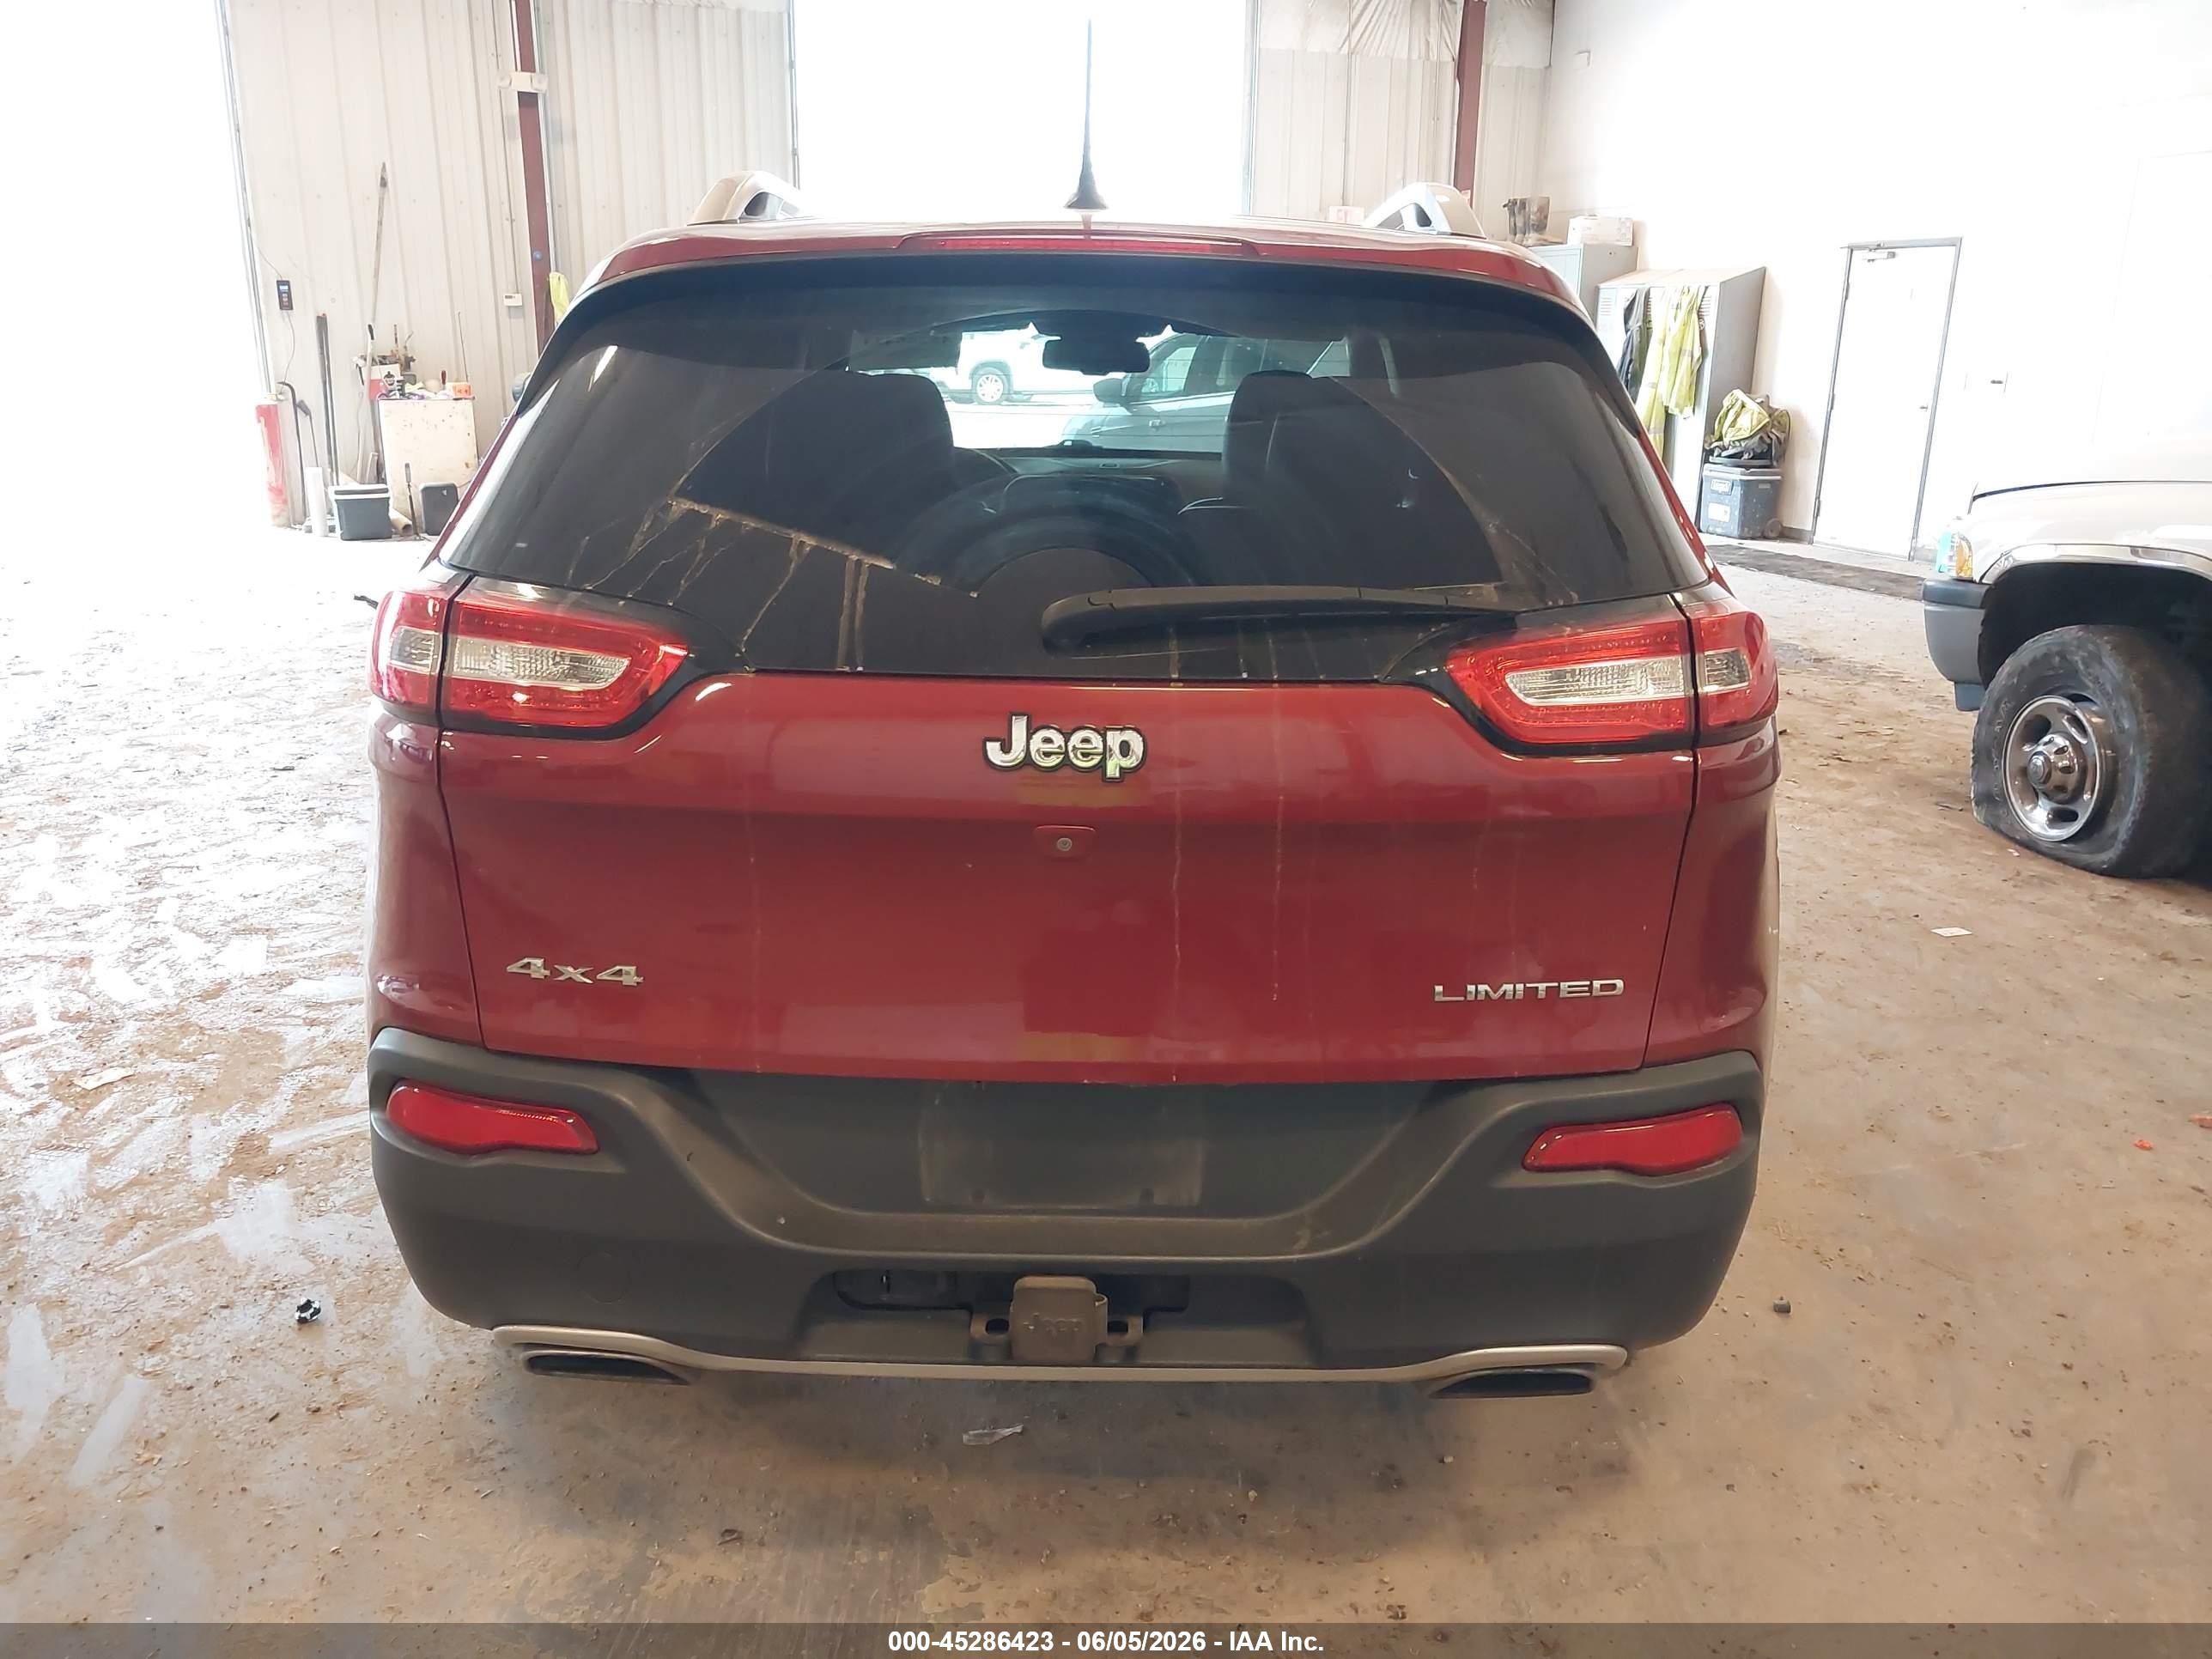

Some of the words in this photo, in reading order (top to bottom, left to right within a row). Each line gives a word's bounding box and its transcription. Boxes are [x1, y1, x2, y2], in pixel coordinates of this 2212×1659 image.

[984, 714, 1146, 781] Jeep
[506, 957, 645, 987] 4x4
[1433, 978, 1626, 1003] LIMITED
